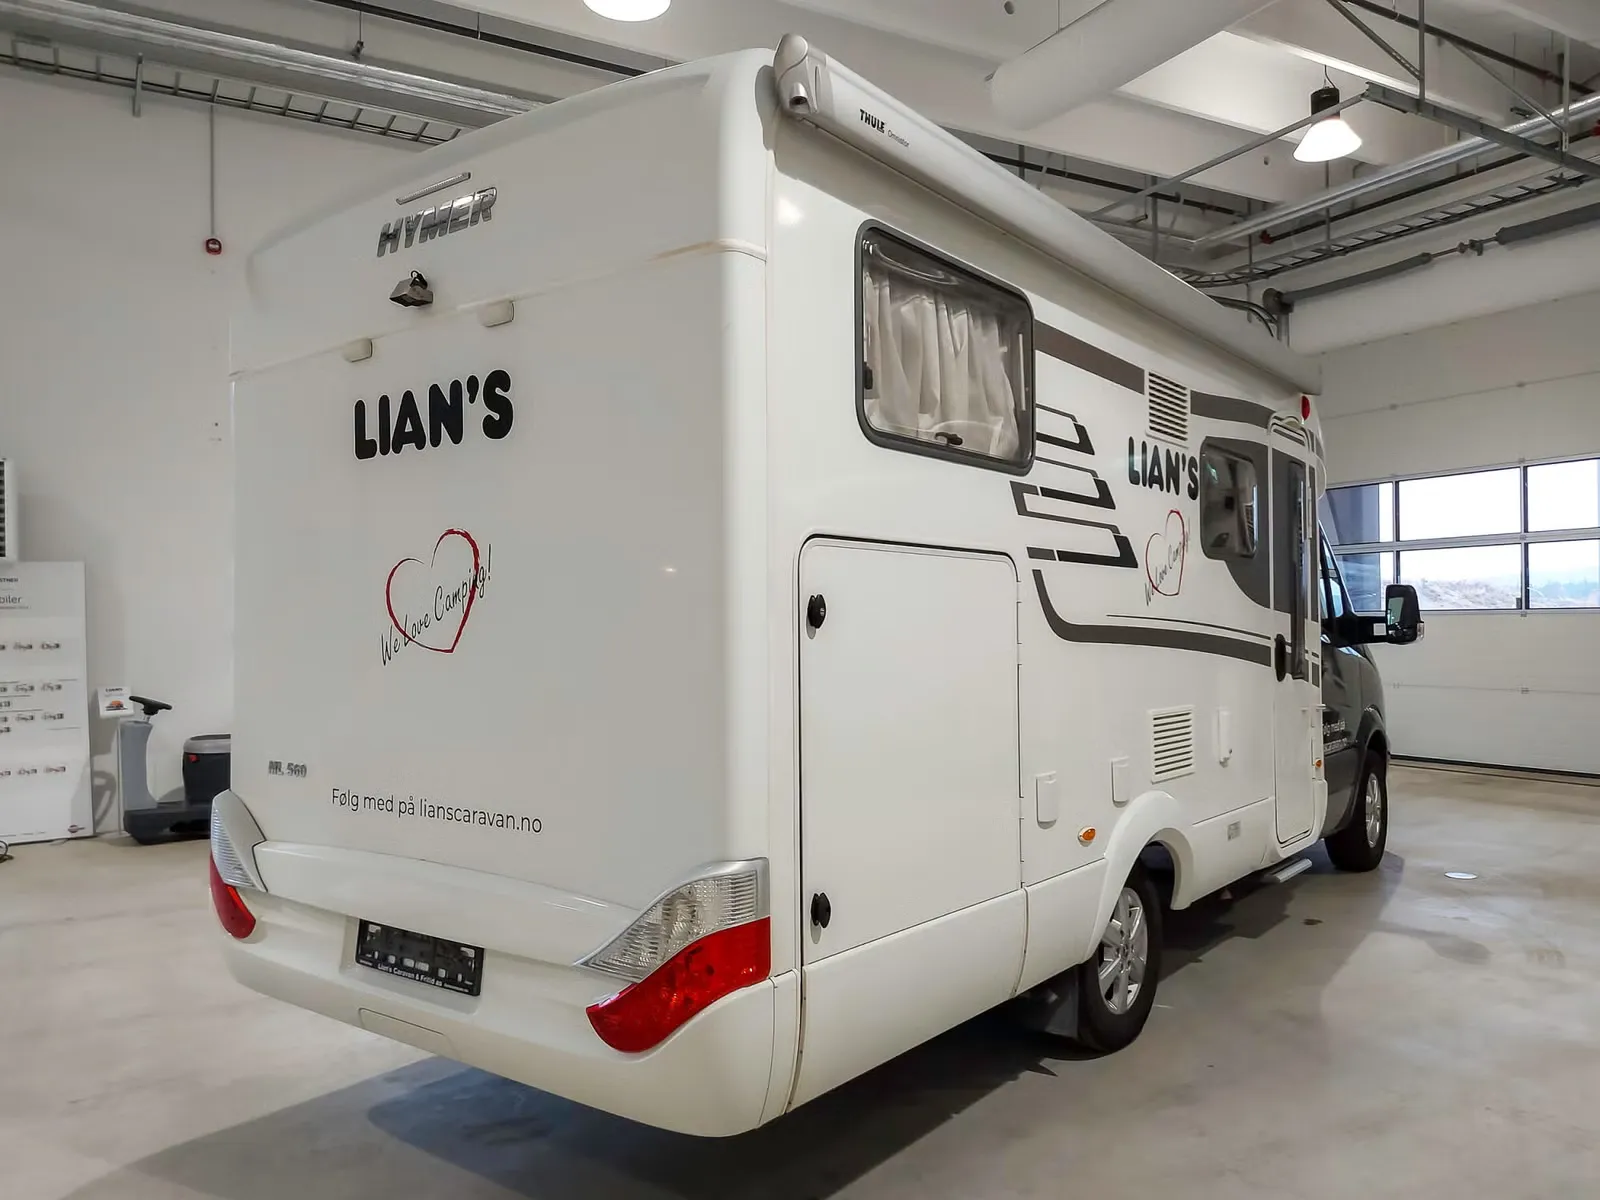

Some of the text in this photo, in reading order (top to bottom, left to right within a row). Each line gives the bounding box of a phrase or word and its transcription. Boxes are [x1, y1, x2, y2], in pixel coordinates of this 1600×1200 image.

[859, 108, 885, 134] THULE
[377, 186, 498, 258] HYMER
[353, 368, 515, 461] LIAN'S
[1128, 436, 1200, 501] LIAN'S
[380, 543, 493, 667] We Love Camping!
[332, 788, 543, 834] Følg med på lianscaravan.no
